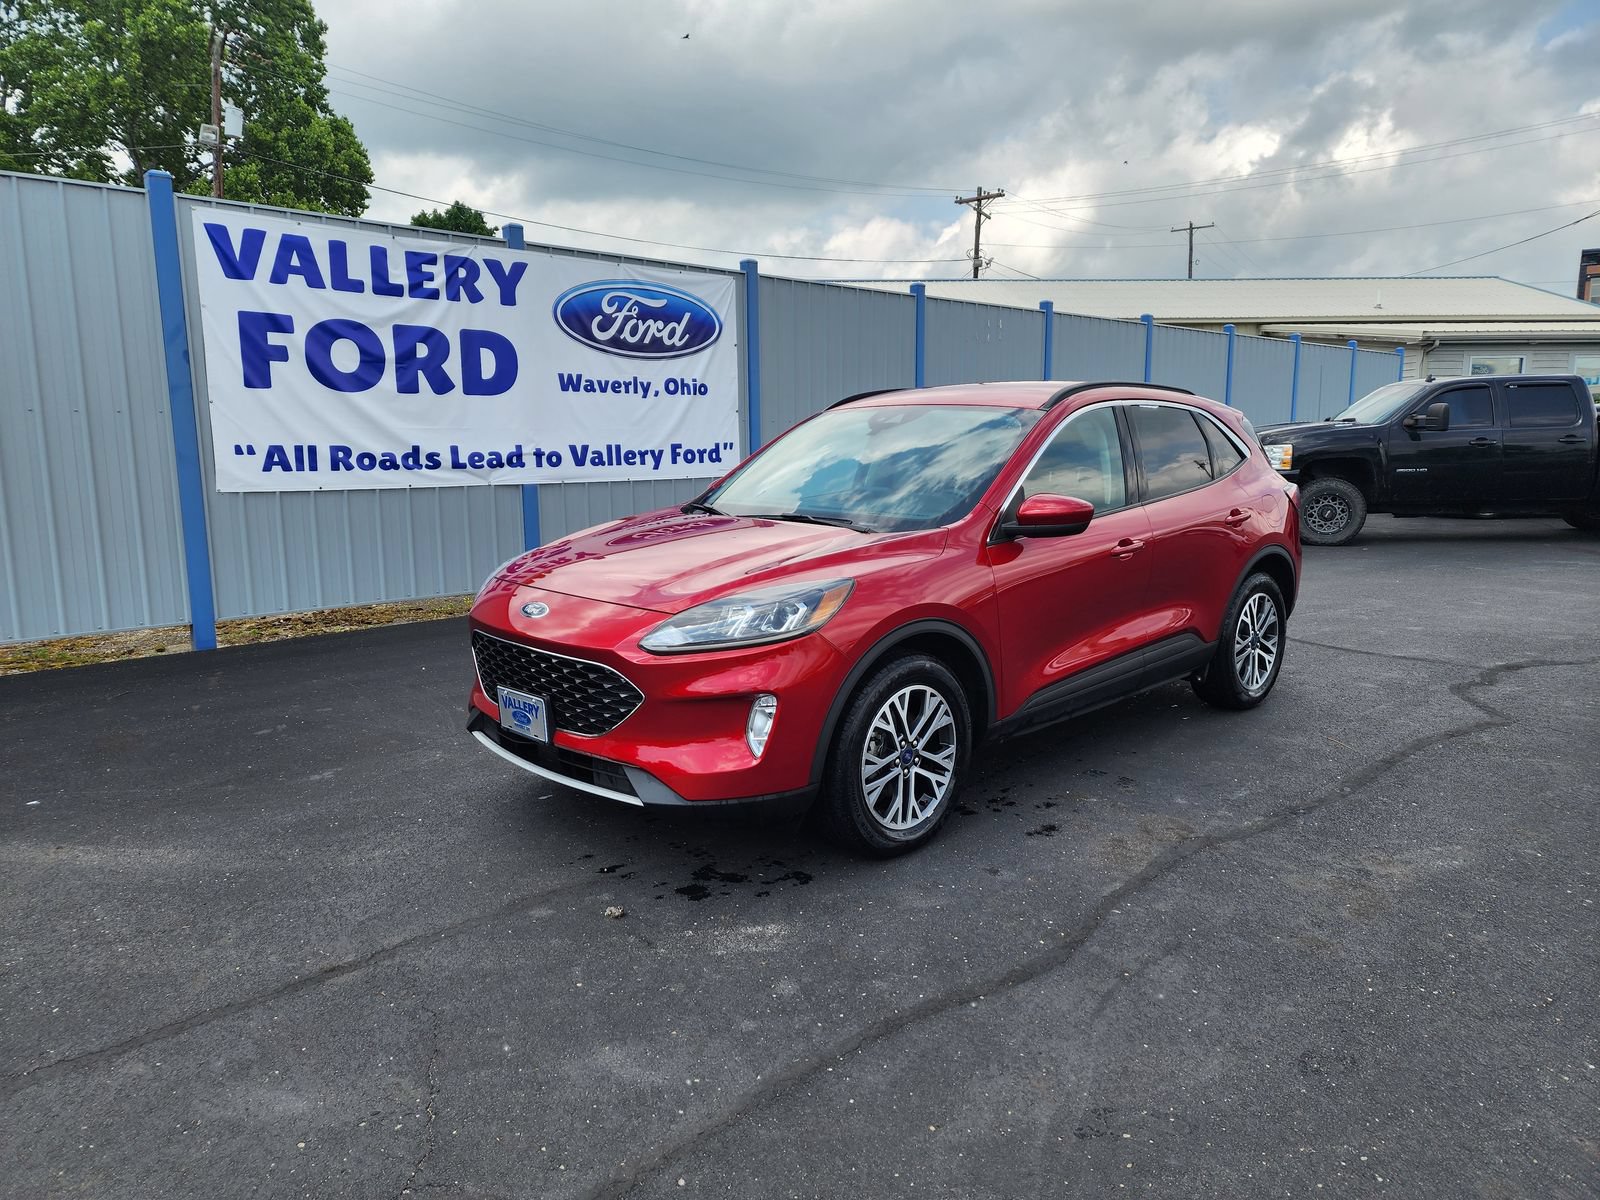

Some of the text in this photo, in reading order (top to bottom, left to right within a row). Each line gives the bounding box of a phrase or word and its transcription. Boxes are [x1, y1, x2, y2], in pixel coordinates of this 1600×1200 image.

[203, 222, 528, 307] VALLERY
[591, 291, 691, 347] Ford
[237, 310, 519, 397] FORD
[557, 372, 709, 399] Waverly, Ohio
[329, 445, 442, 472] Roads
[449, 444, 526, 470] Lead
[532, 447, 563, 468] to
[568, 444, 665, 471] Vallery
[501, 694, 540, 719] VALLERY
